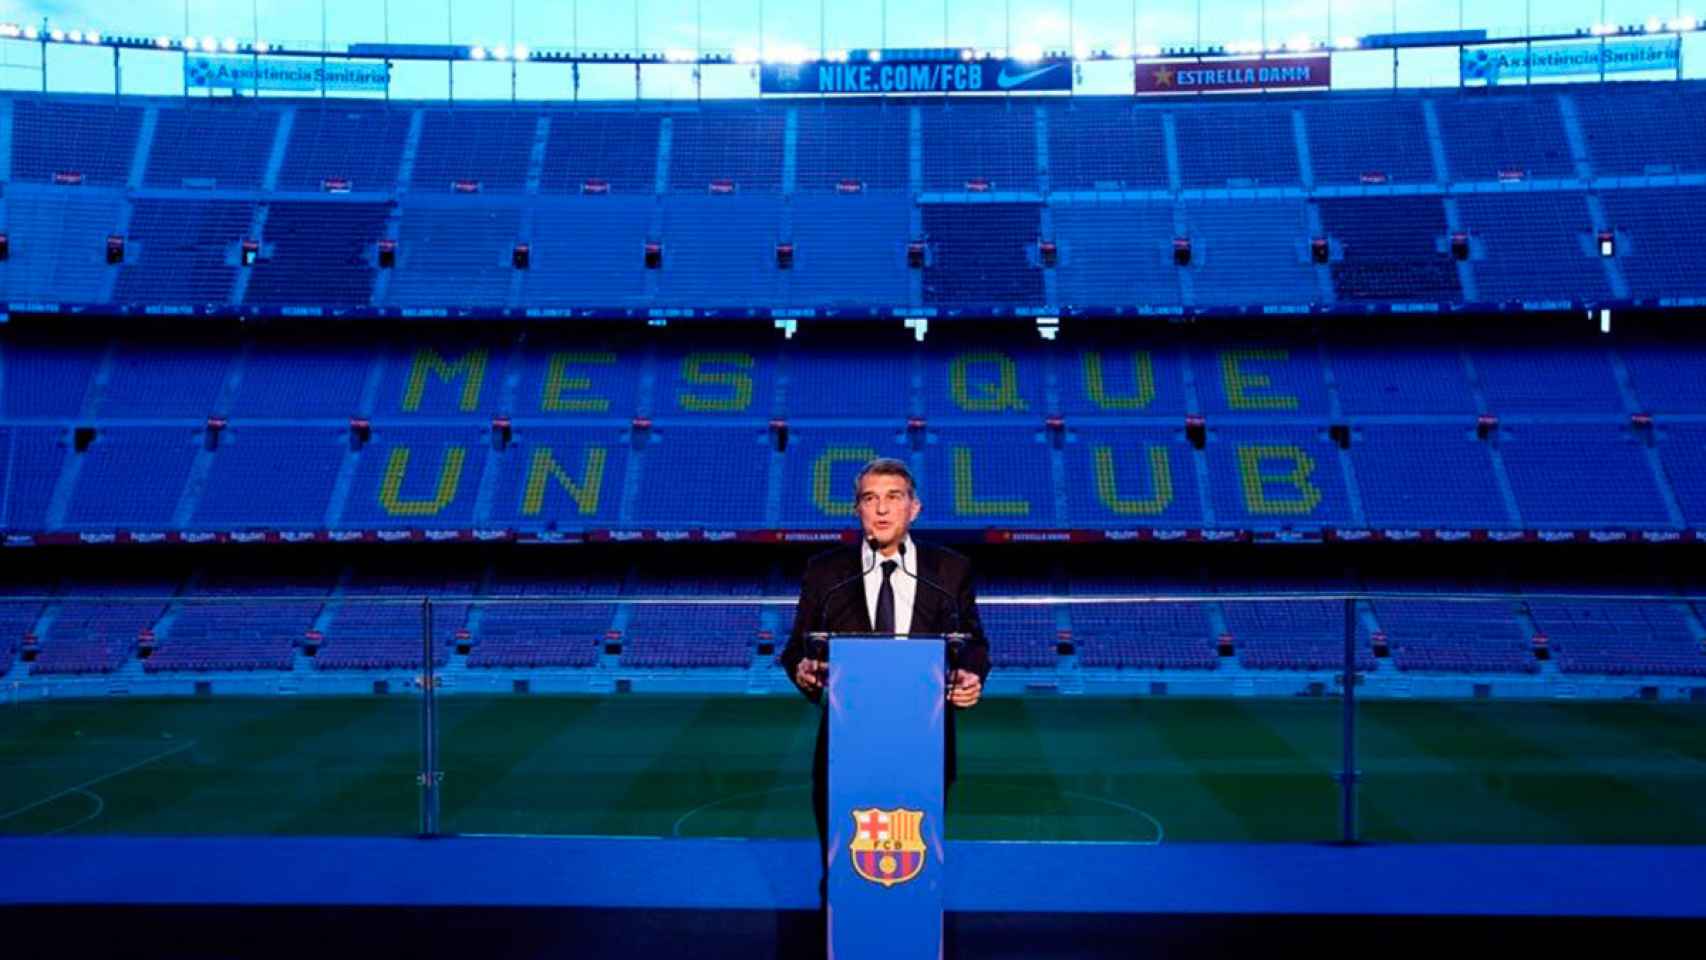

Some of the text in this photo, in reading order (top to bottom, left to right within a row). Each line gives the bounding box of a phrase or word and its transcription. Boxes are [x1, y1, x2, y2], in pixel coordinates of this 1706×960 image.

[819, 63, 982, 91] NIKE.COM/FCB
[1177, 62, 1311, 85] ESTRELLA DAMM
[402, 349, 1298, 412] MES QUE
[379, 444, 1323, 516] UN CLUB
